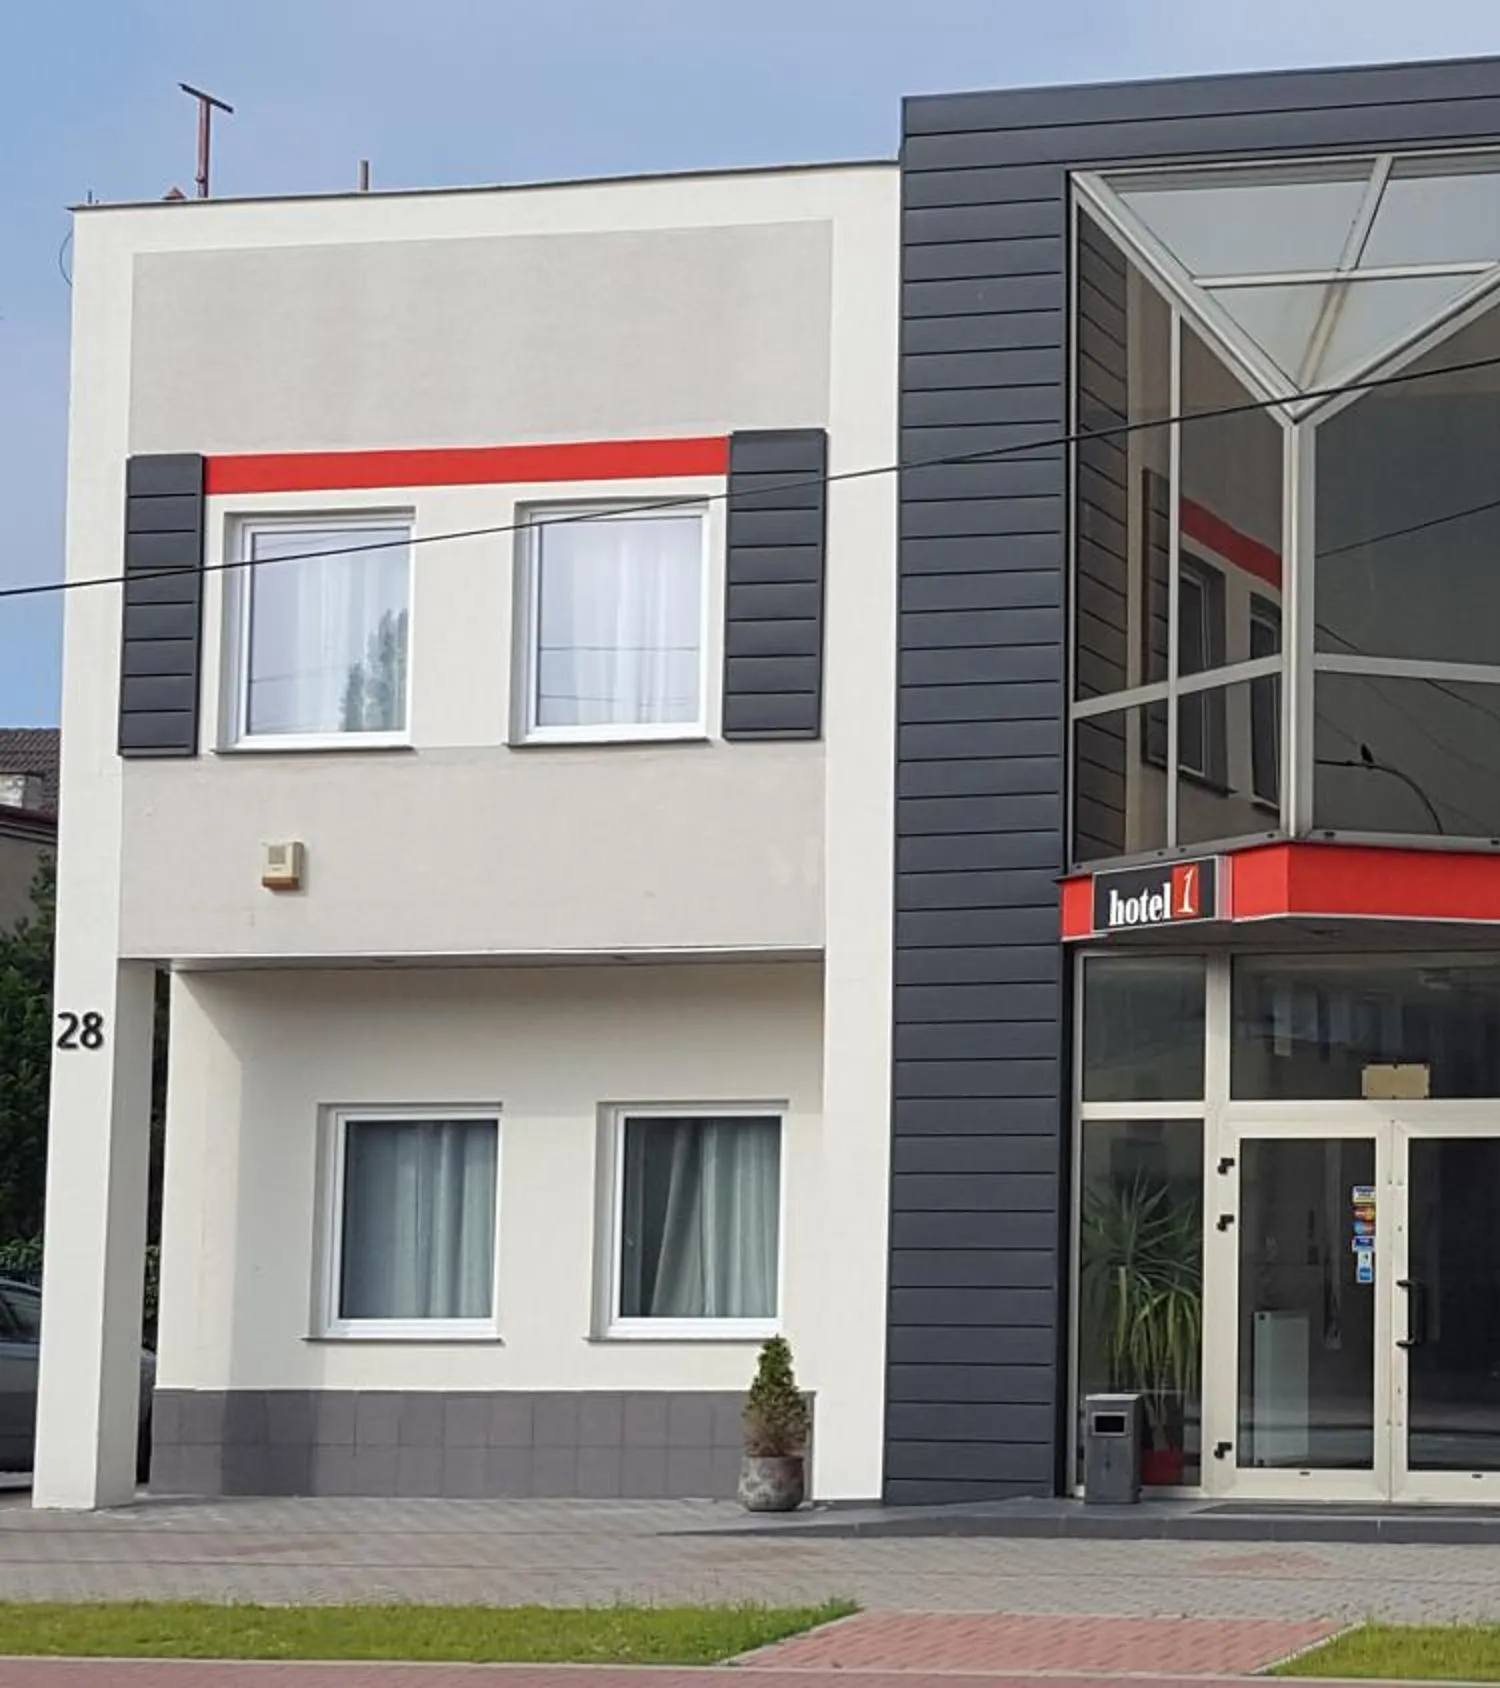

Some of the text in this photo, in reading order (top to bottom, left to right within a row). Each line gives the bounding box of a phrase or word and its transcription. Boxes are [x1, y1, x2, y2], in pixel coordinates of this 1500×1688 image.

[1110, 867, 1195, 926] hotel 1
[57, 1011, 104, 1050] 28
